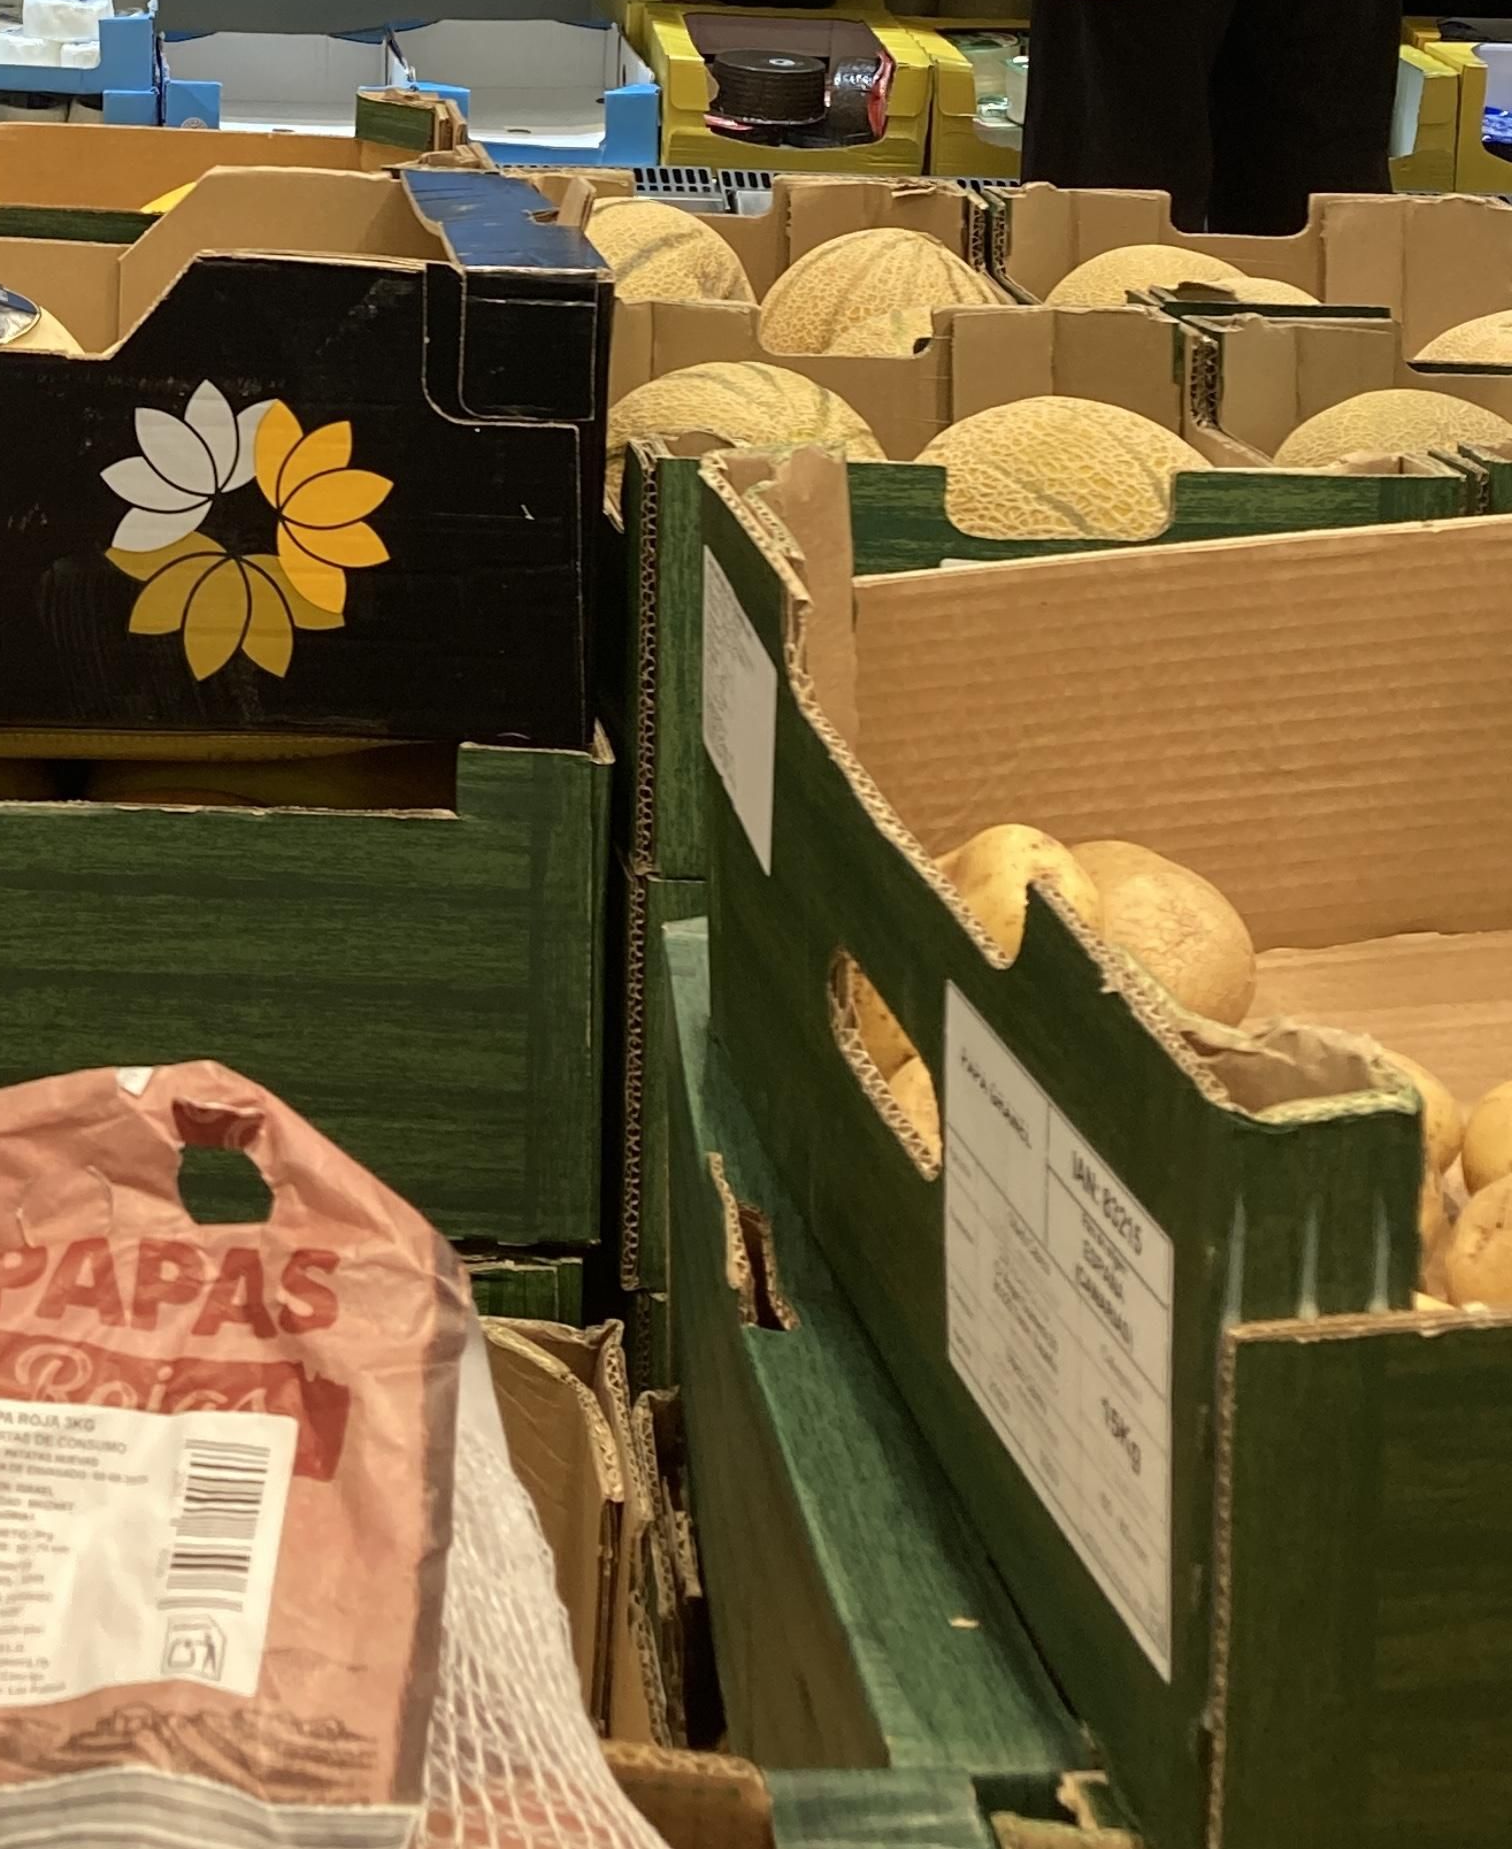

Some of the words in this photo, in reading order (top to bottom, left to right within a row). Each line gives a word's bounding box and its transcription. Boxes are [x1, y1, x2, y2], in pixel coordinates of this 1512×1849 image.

[18, 1411, 60, 1430] ROJA
[64, 1416, 96, 1433] 3KG
[34, 1432, 52, 1448] DE
[56, 1435, 128, 1454] CONSUMO
